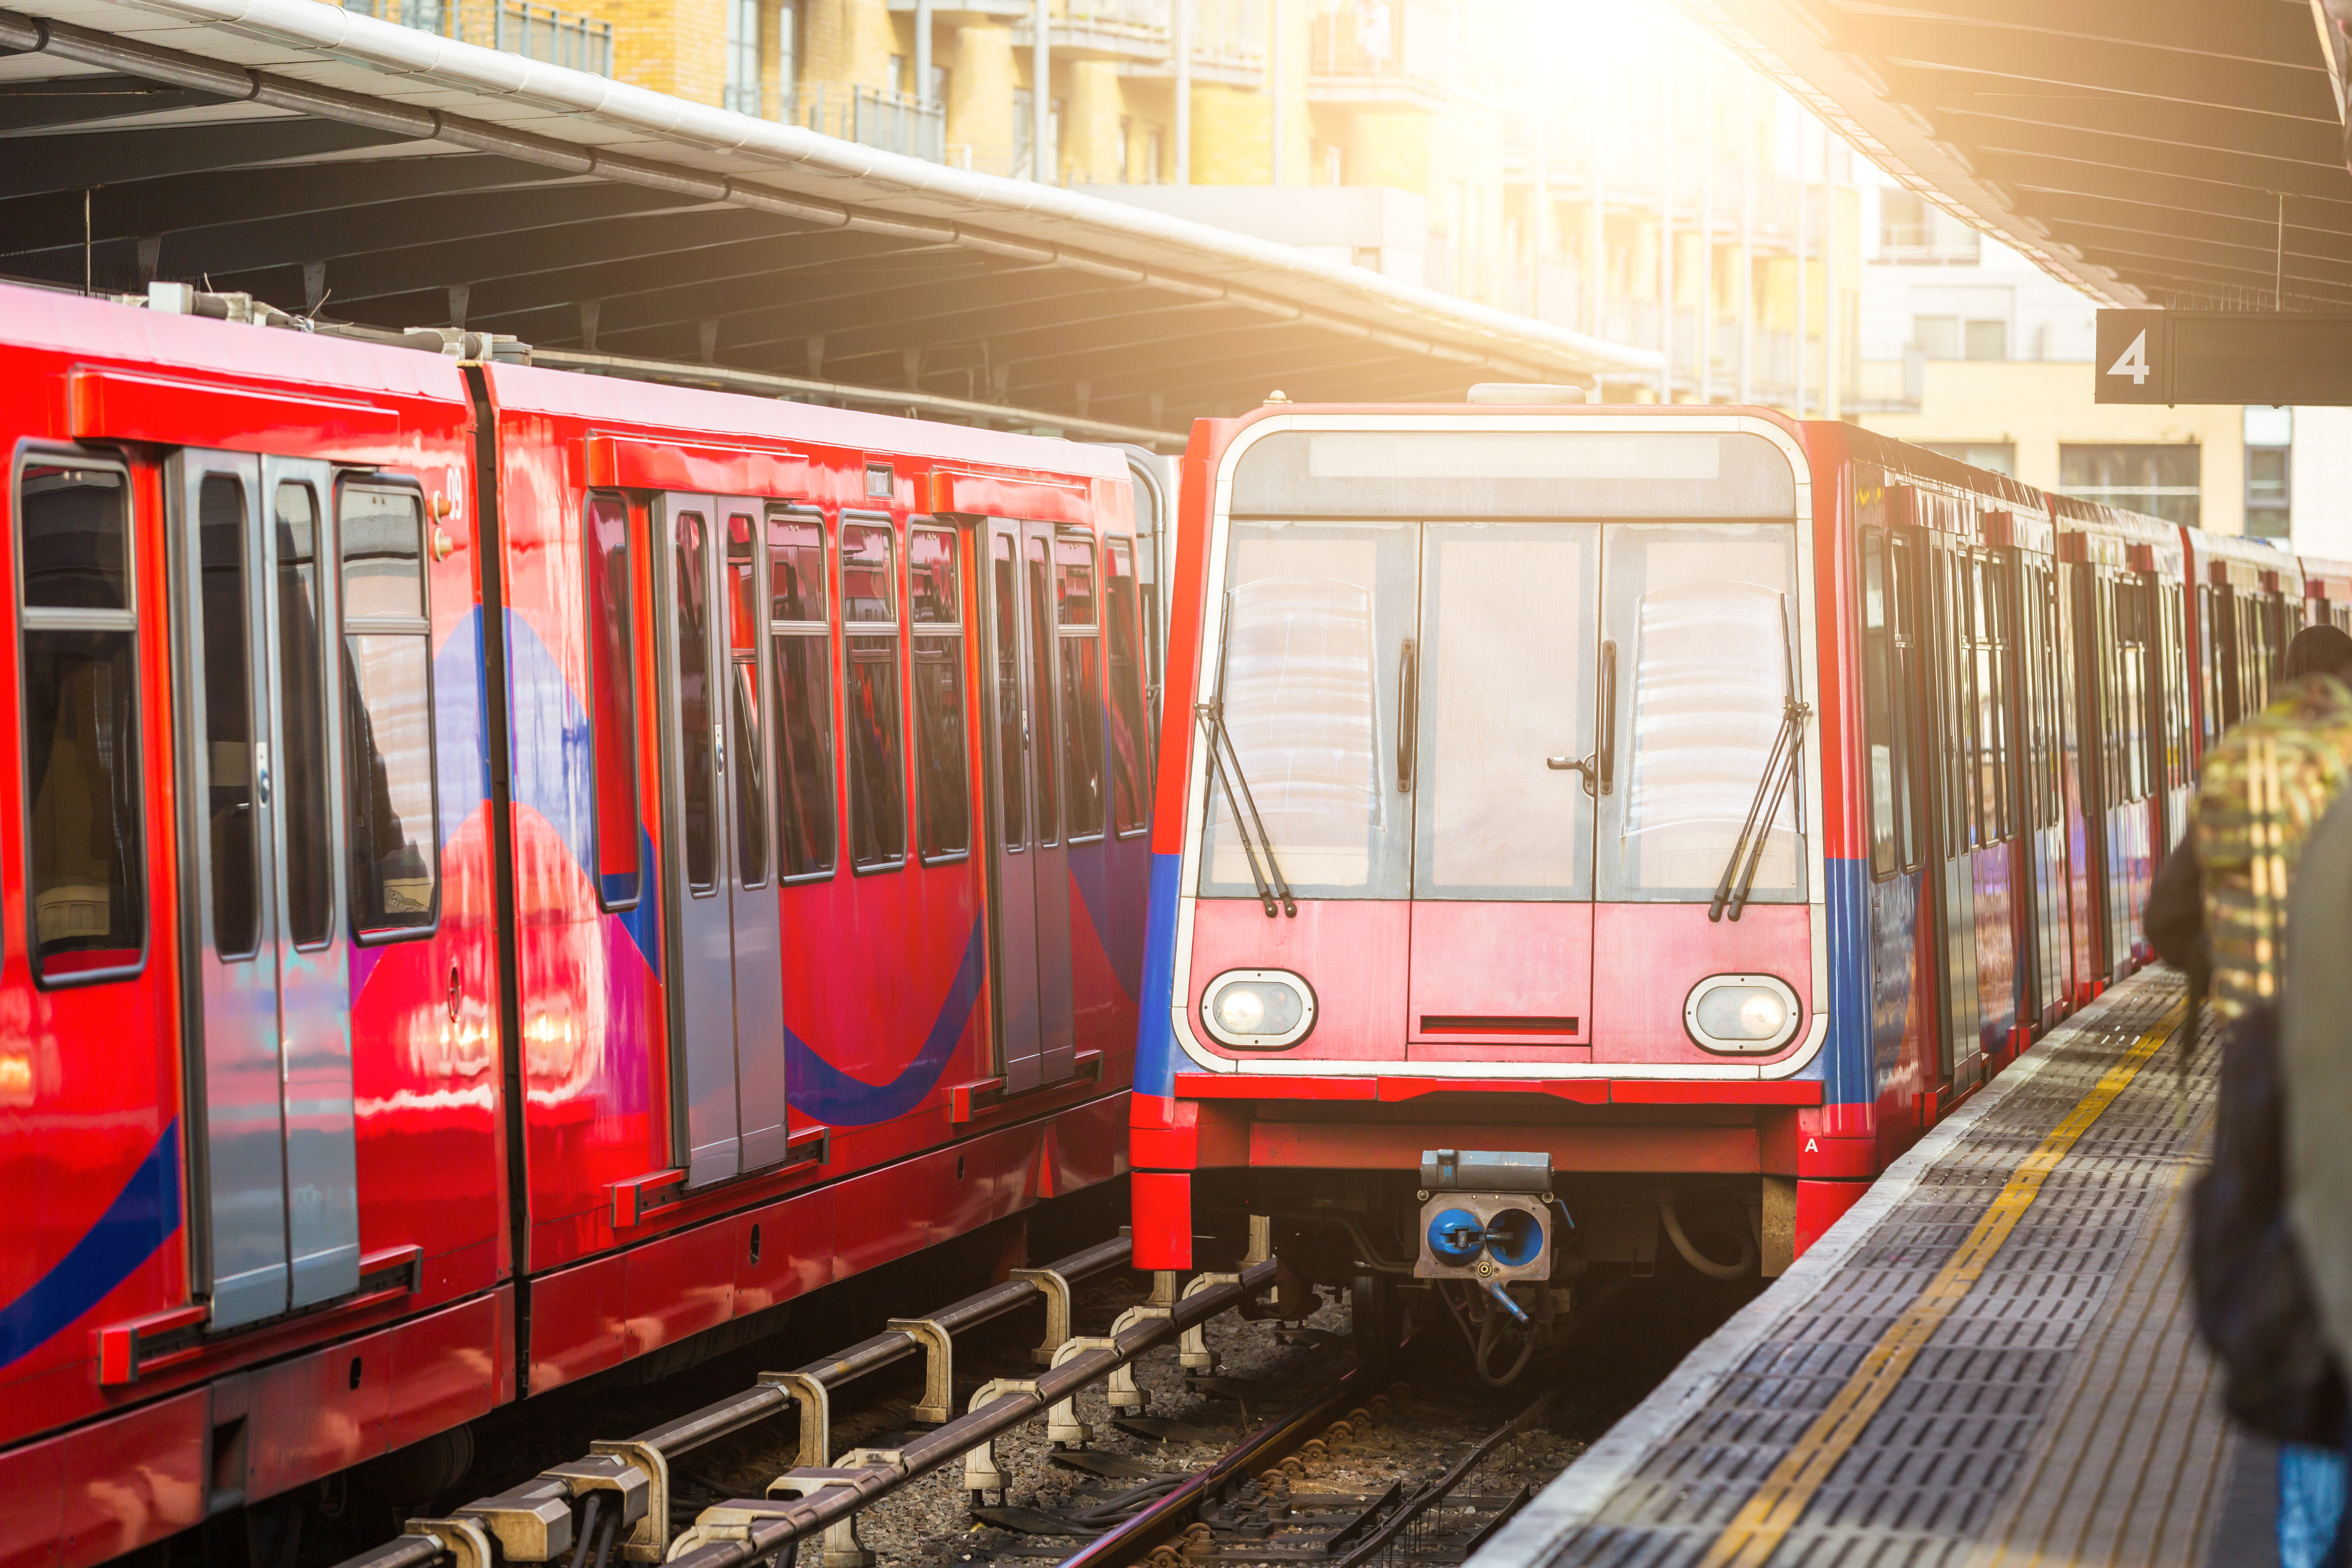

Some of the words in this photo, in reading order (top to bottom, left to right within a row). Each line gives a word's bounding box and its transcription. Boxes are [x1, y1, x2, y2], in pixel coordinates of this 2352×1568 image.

[2107, 328, 2149, 384] 4
[446, 468, 463, 520] 09
[1804, 1138, 1818, 1152] A
